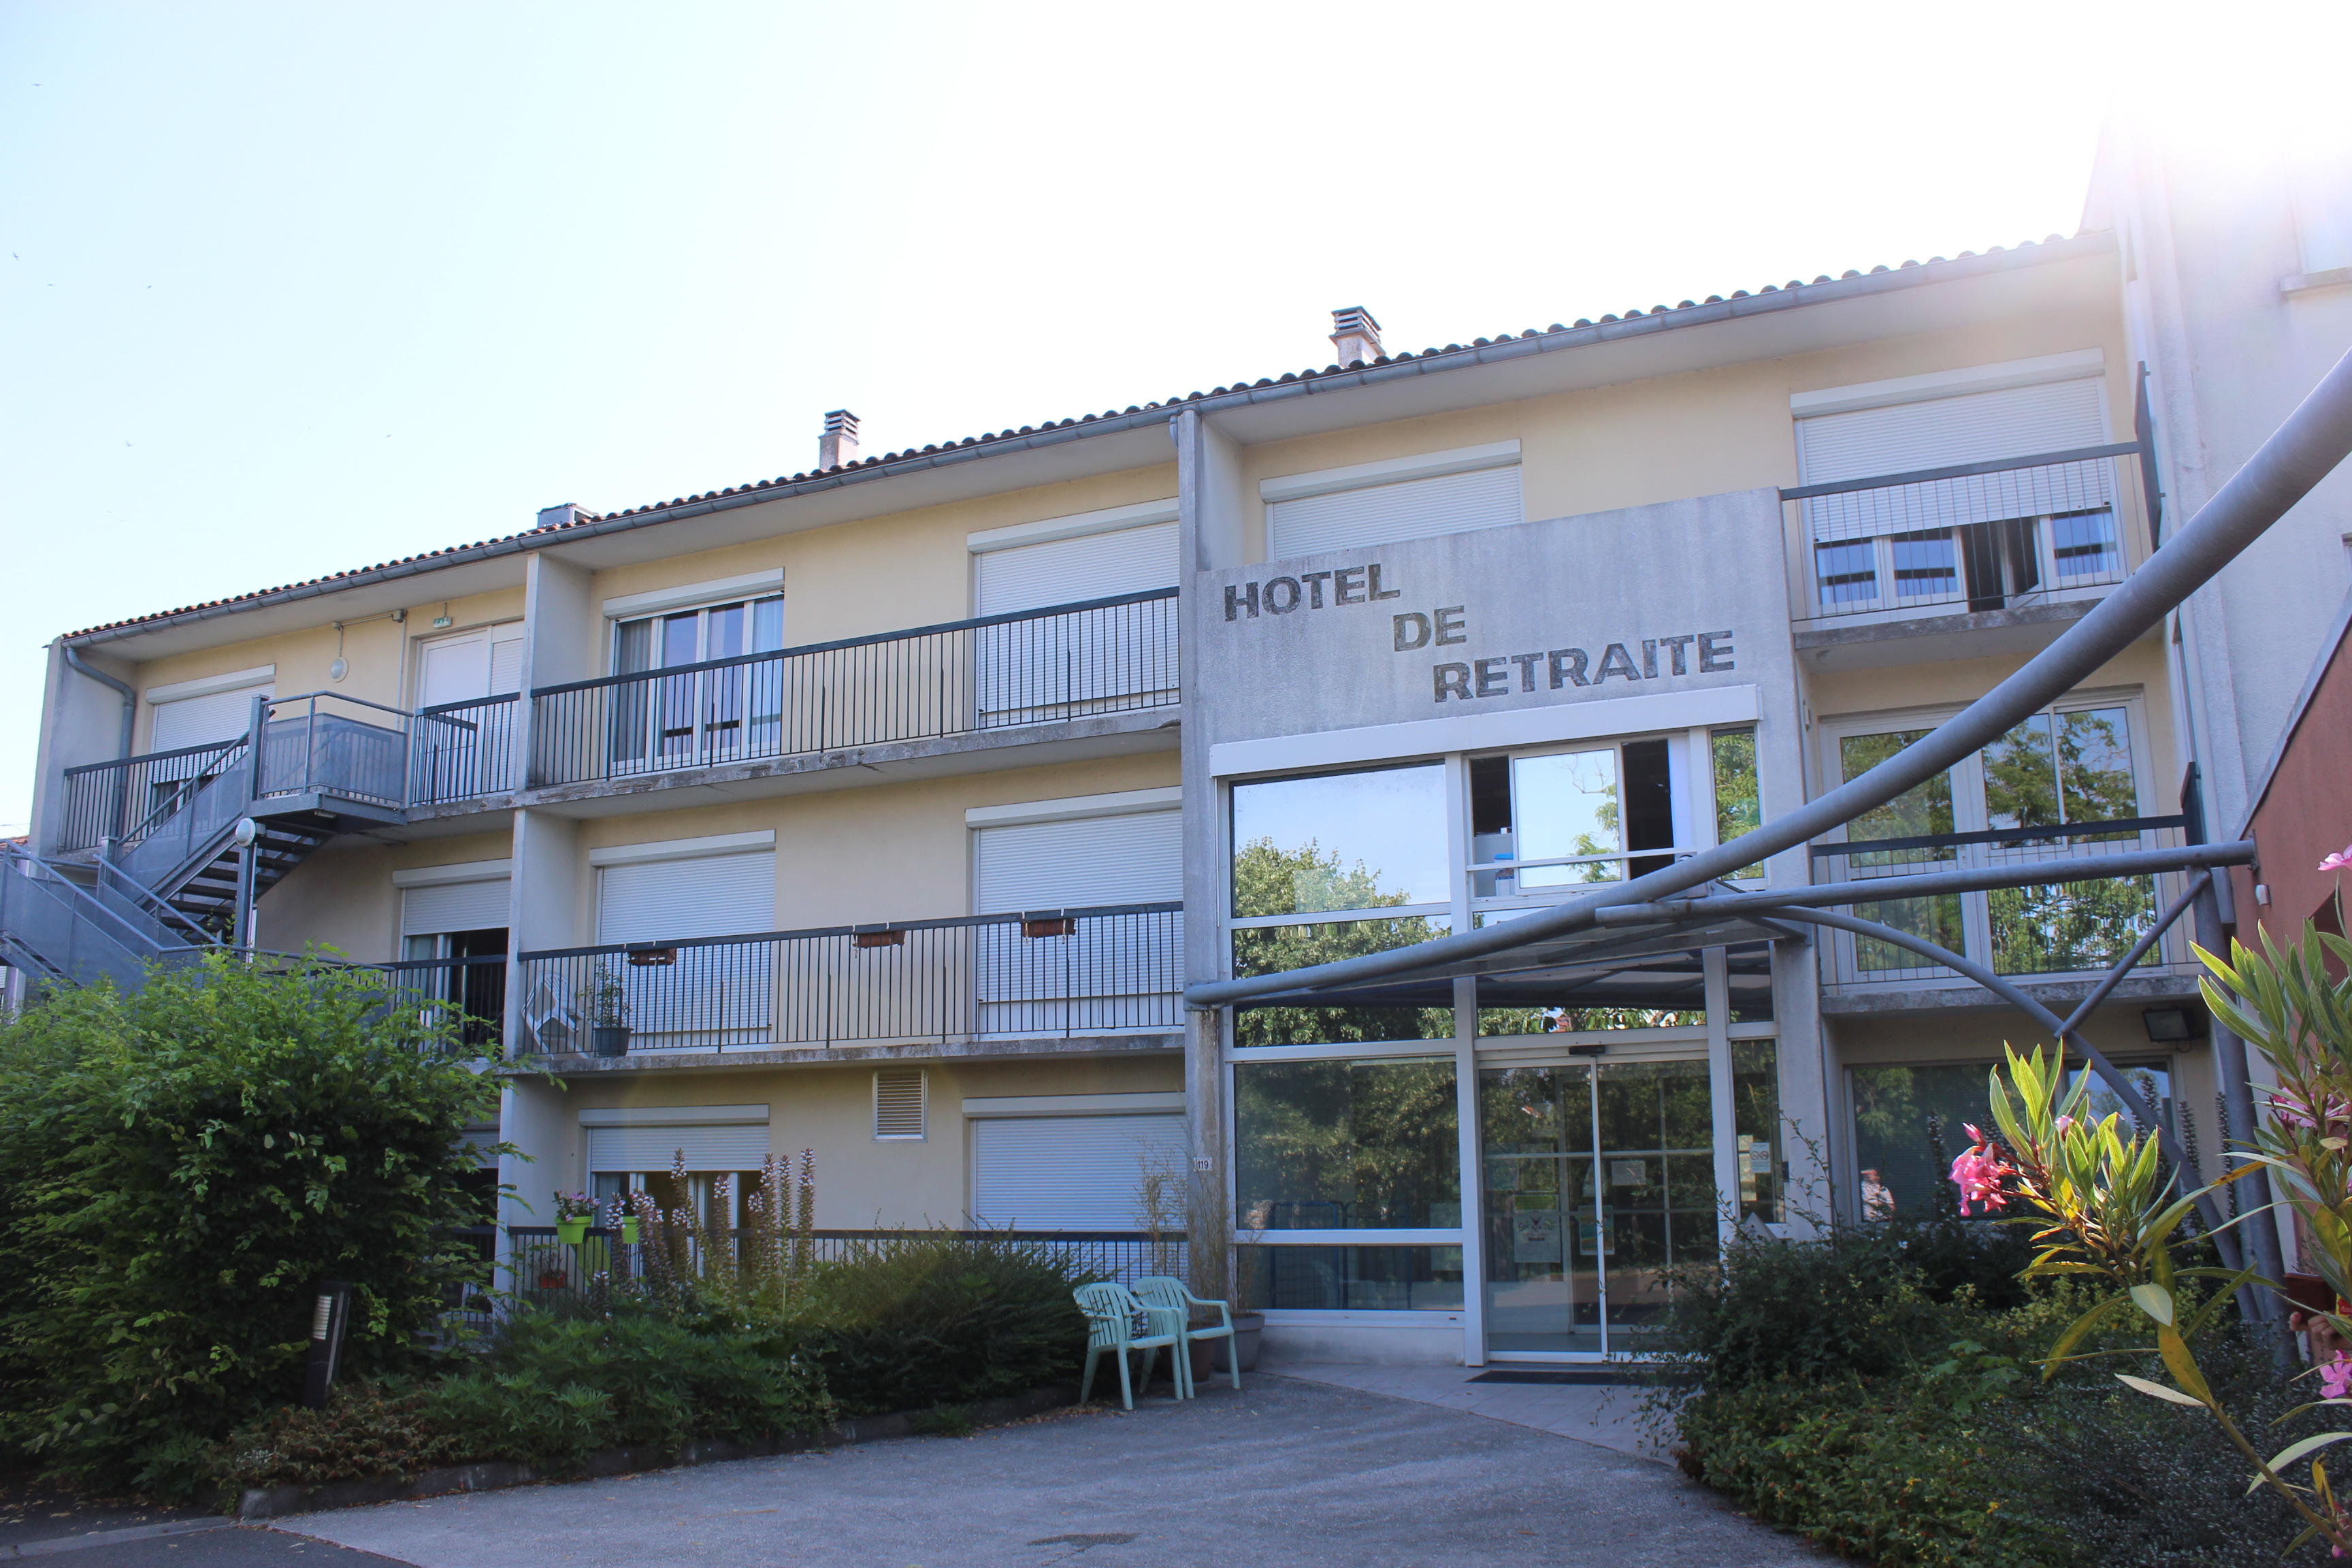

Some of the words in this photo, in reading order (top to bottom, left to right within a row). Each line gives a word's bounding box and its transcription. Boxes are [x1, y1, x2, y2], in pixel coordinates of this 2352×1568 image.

[1225, 564, 1401, 621] HOTEL
[1393, 605, 1467, 651] DE
[1433, 630, 1735, 703] RETRAITE
[1198, 1160, 1209, 1169] 119
